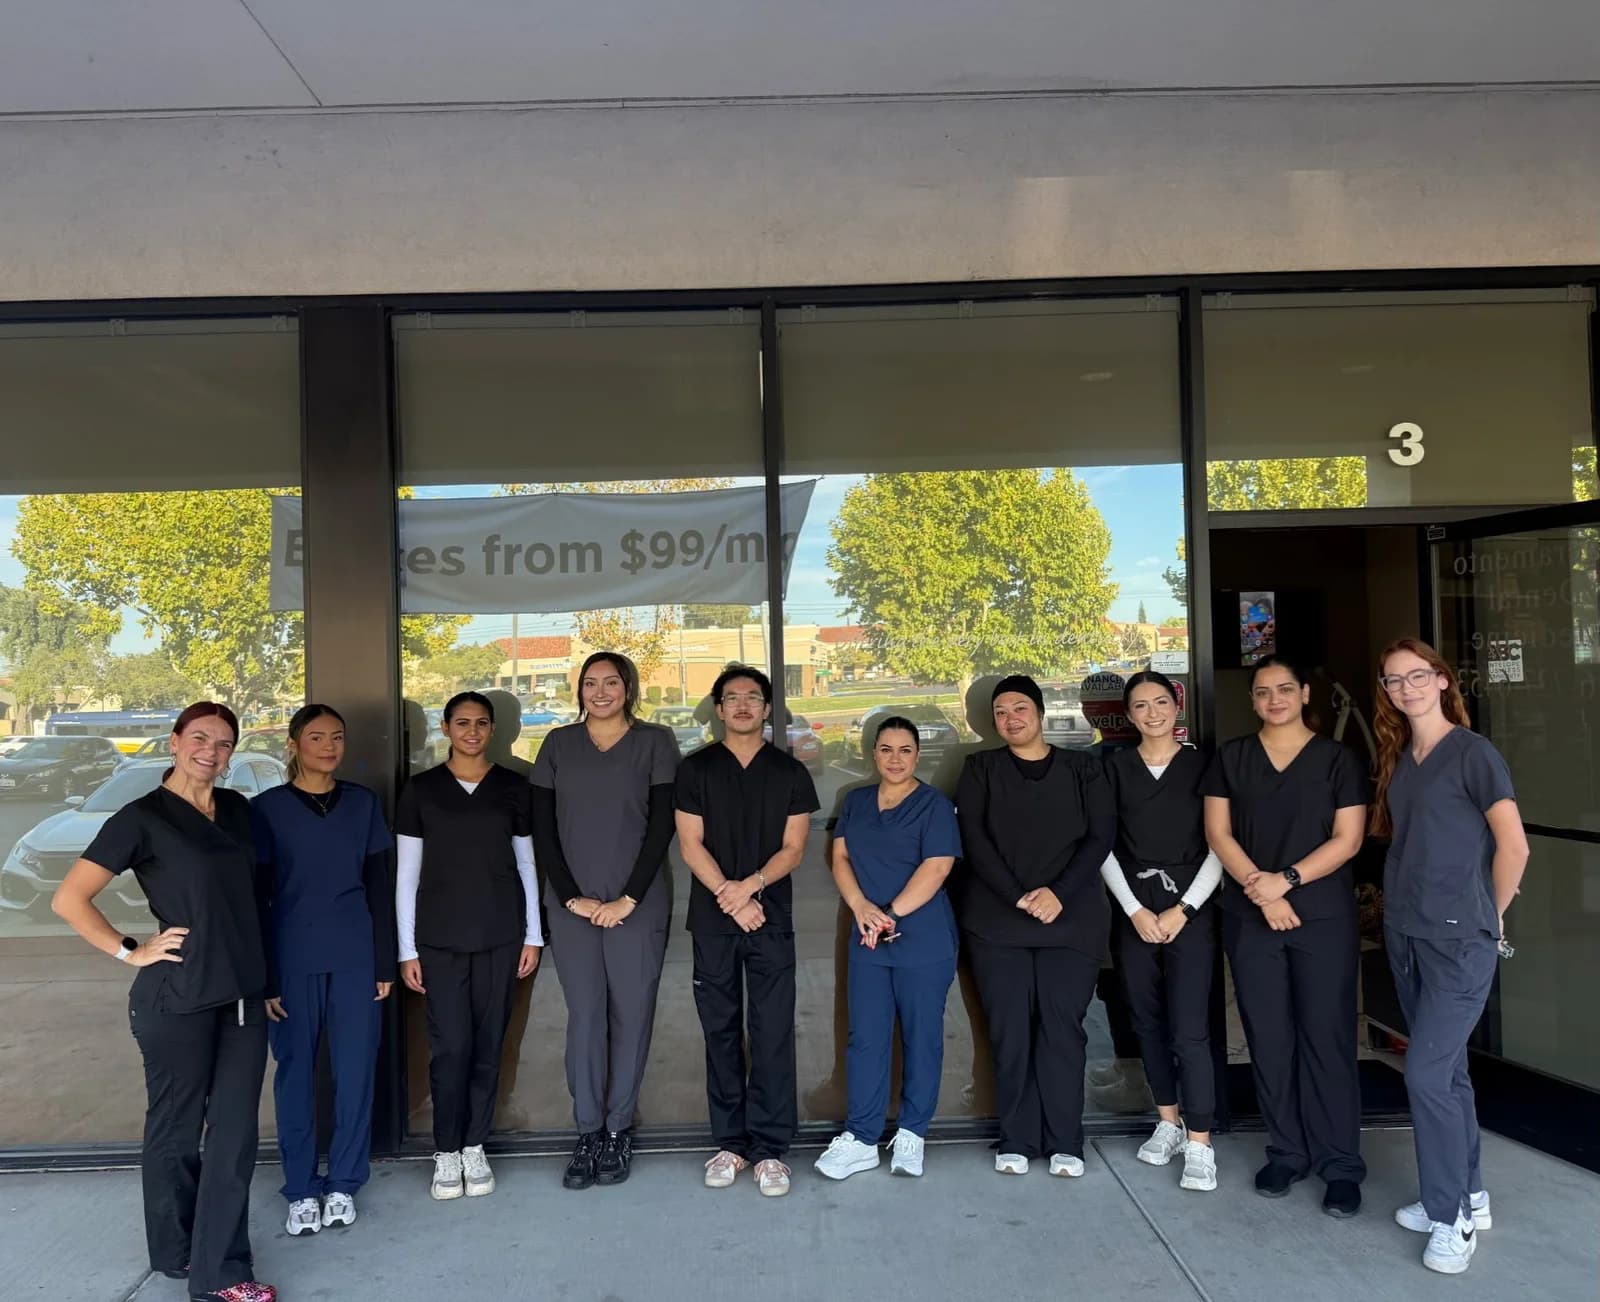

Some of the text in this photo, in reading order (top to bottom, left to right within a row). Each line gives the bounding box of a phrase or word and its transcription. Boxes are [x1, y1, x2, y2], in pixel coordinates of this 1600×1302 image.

[1388, 422, 1425, 466] 3
[482, 534, 602, 575] from
[1092, 714, 1124, 730] yelp
